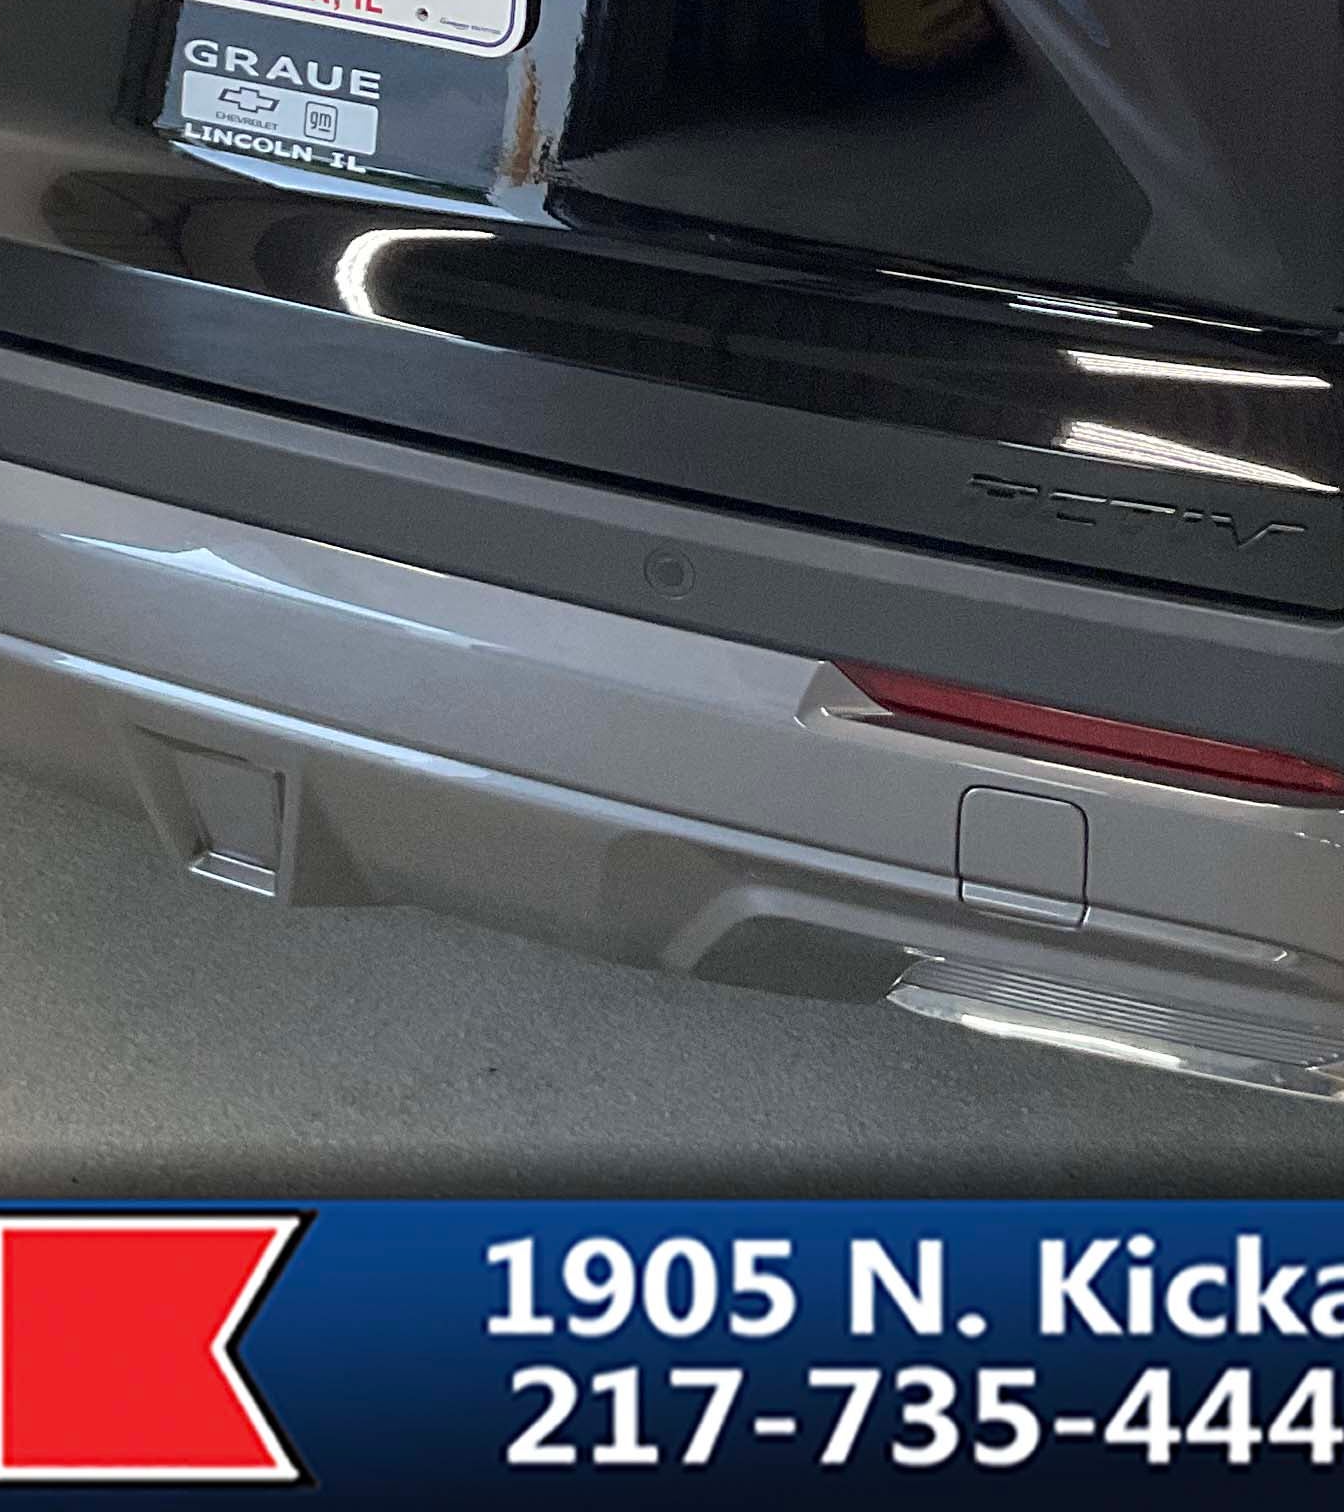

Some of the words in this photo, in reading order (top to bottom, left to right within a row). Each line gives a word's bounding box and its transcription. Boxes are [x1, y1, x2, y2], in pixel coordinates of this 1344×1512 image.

[183, 38, 382, 101] GRAUE
[215, 111, 279, 131] CHEVROLET
[309, 110, 332, 133] gm
[183, 121, 313, 163] LINCOLN
[329, 151, 367, 175] IL
